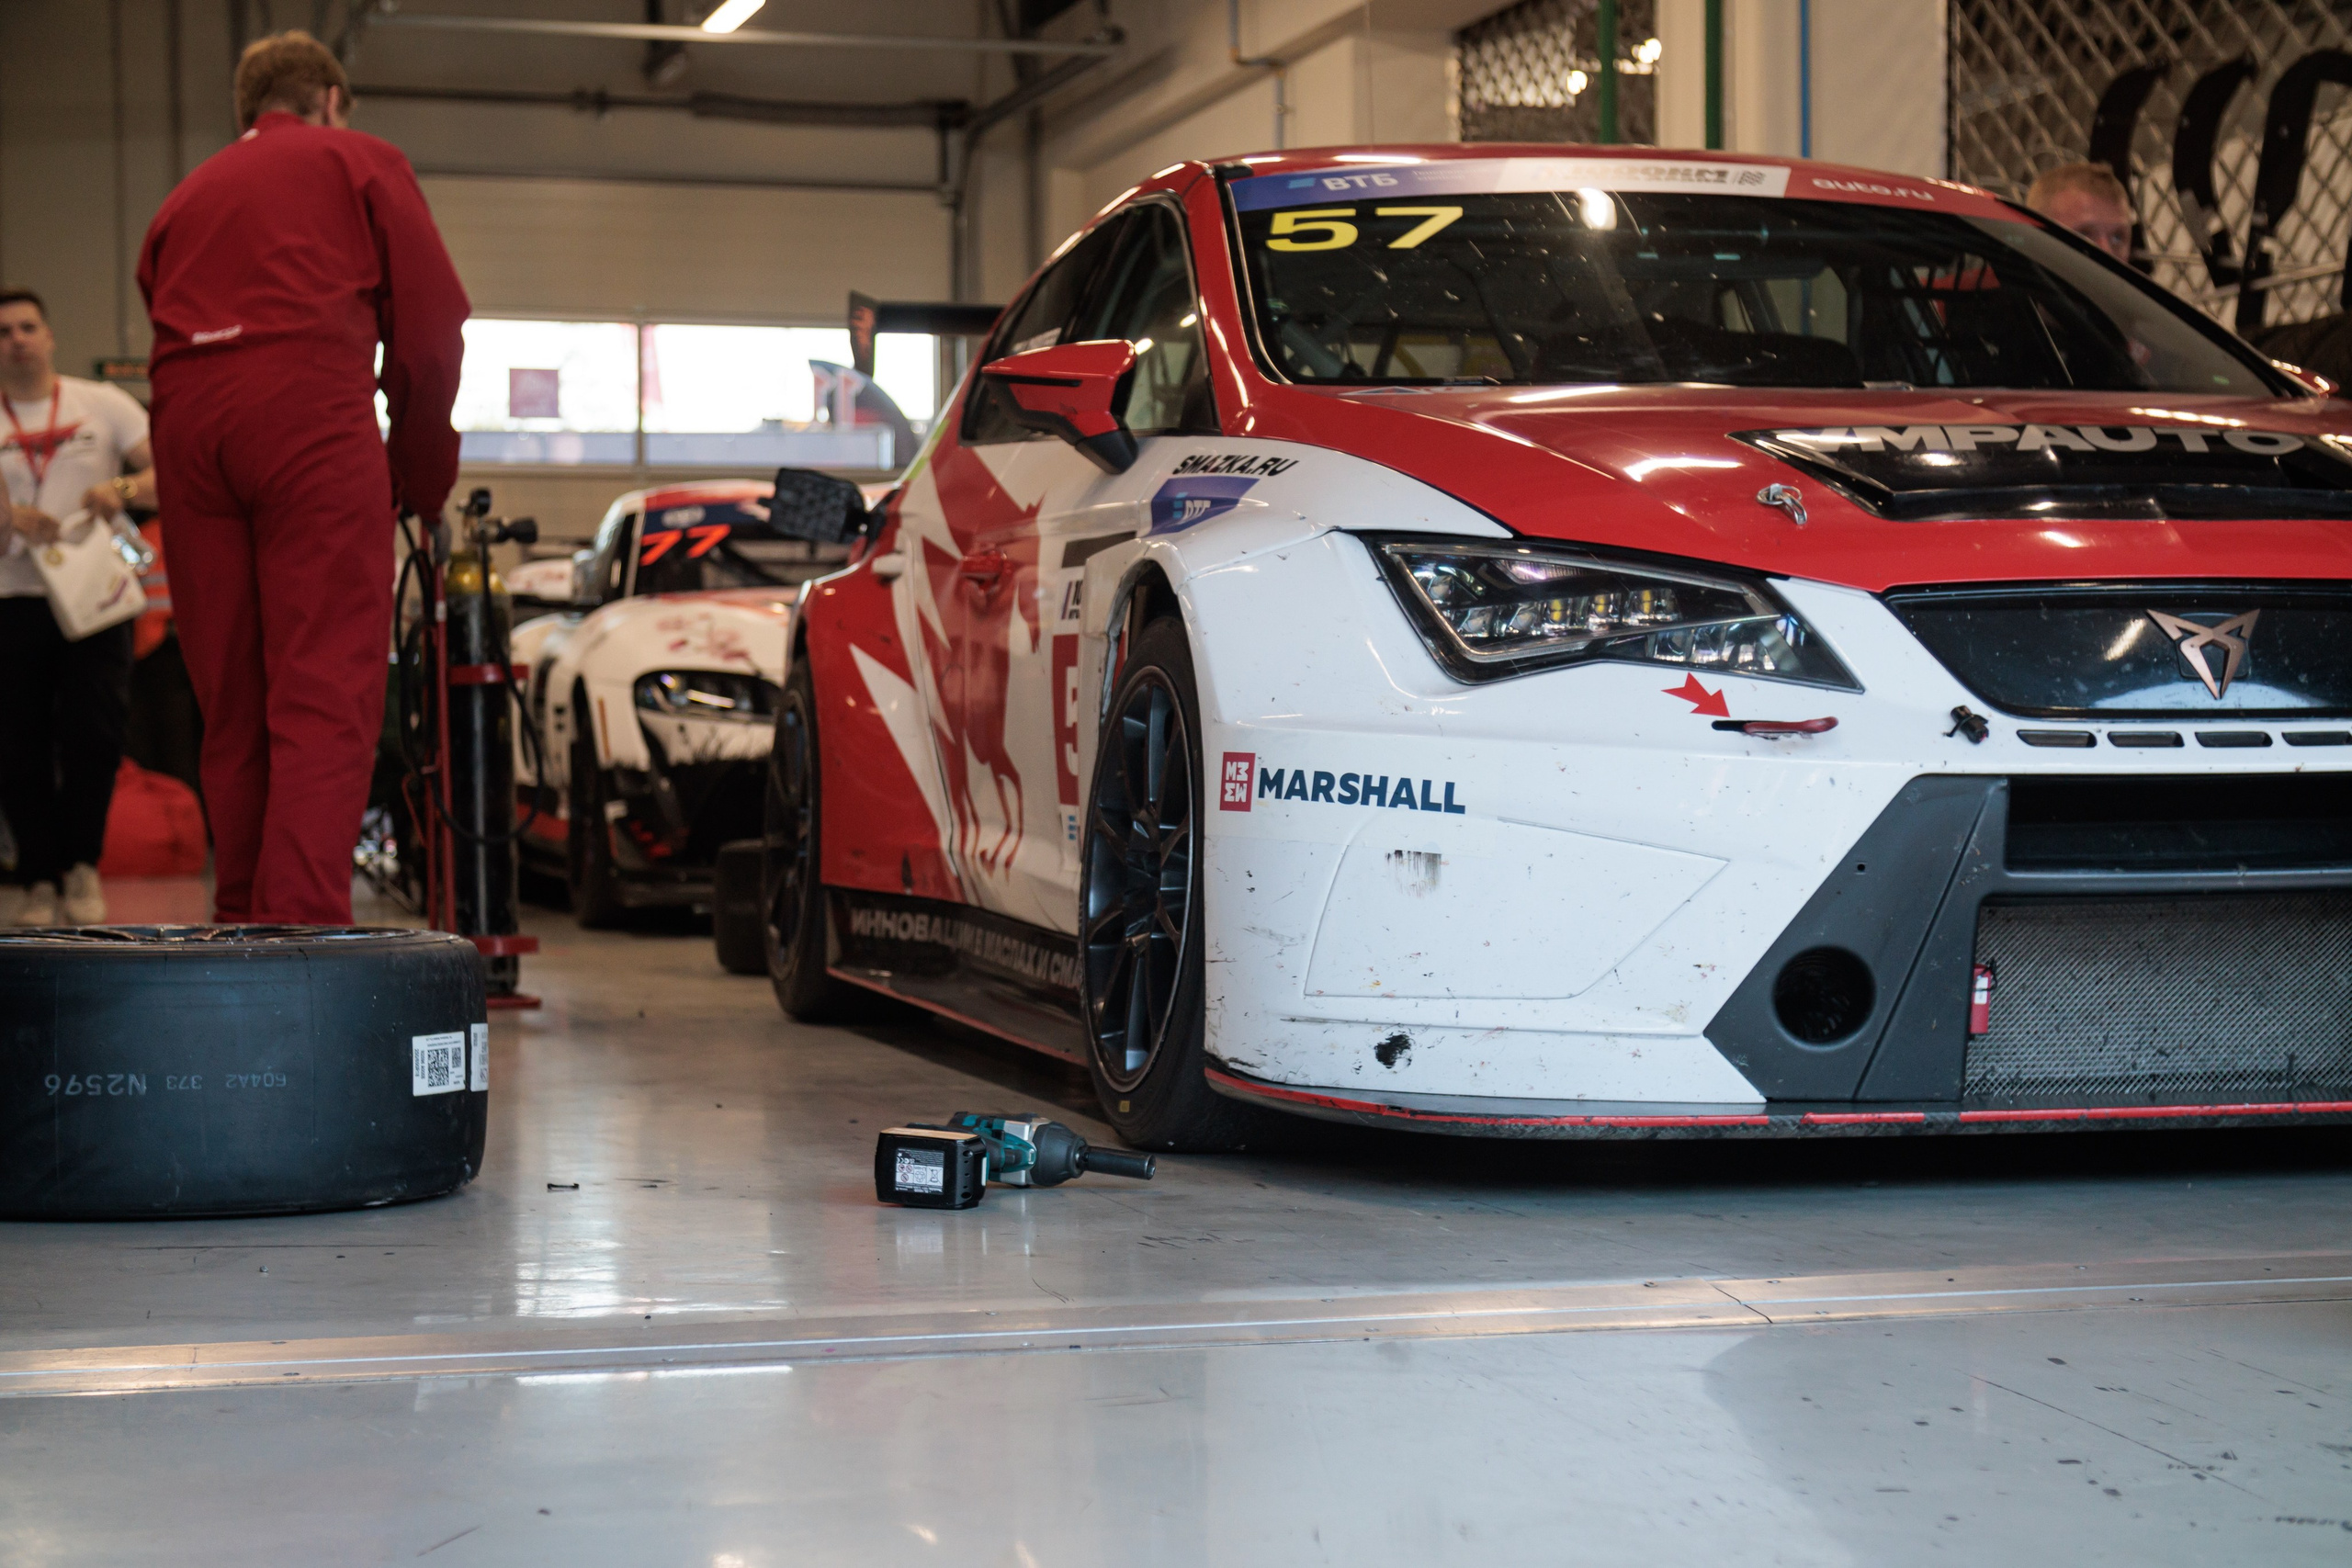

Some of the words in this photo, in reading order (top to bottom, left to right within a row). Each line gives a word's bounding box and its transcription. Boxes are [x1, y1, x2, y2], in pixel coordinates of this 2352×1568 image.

[1321, 173, 1398, 191] ВТБ
[1812, 178, 1935, 201] auto.ru
[1266, 206, 1463, 252] 57
[1172, 455, 1299, 477] SMAZKA.RU
[639, 524, 731, 567] 77
[1258, 767, 1465, 815] MARSHALL
[44, 1073, 147, 1096] N2596
[165, 1075, 203, 1090] 373
